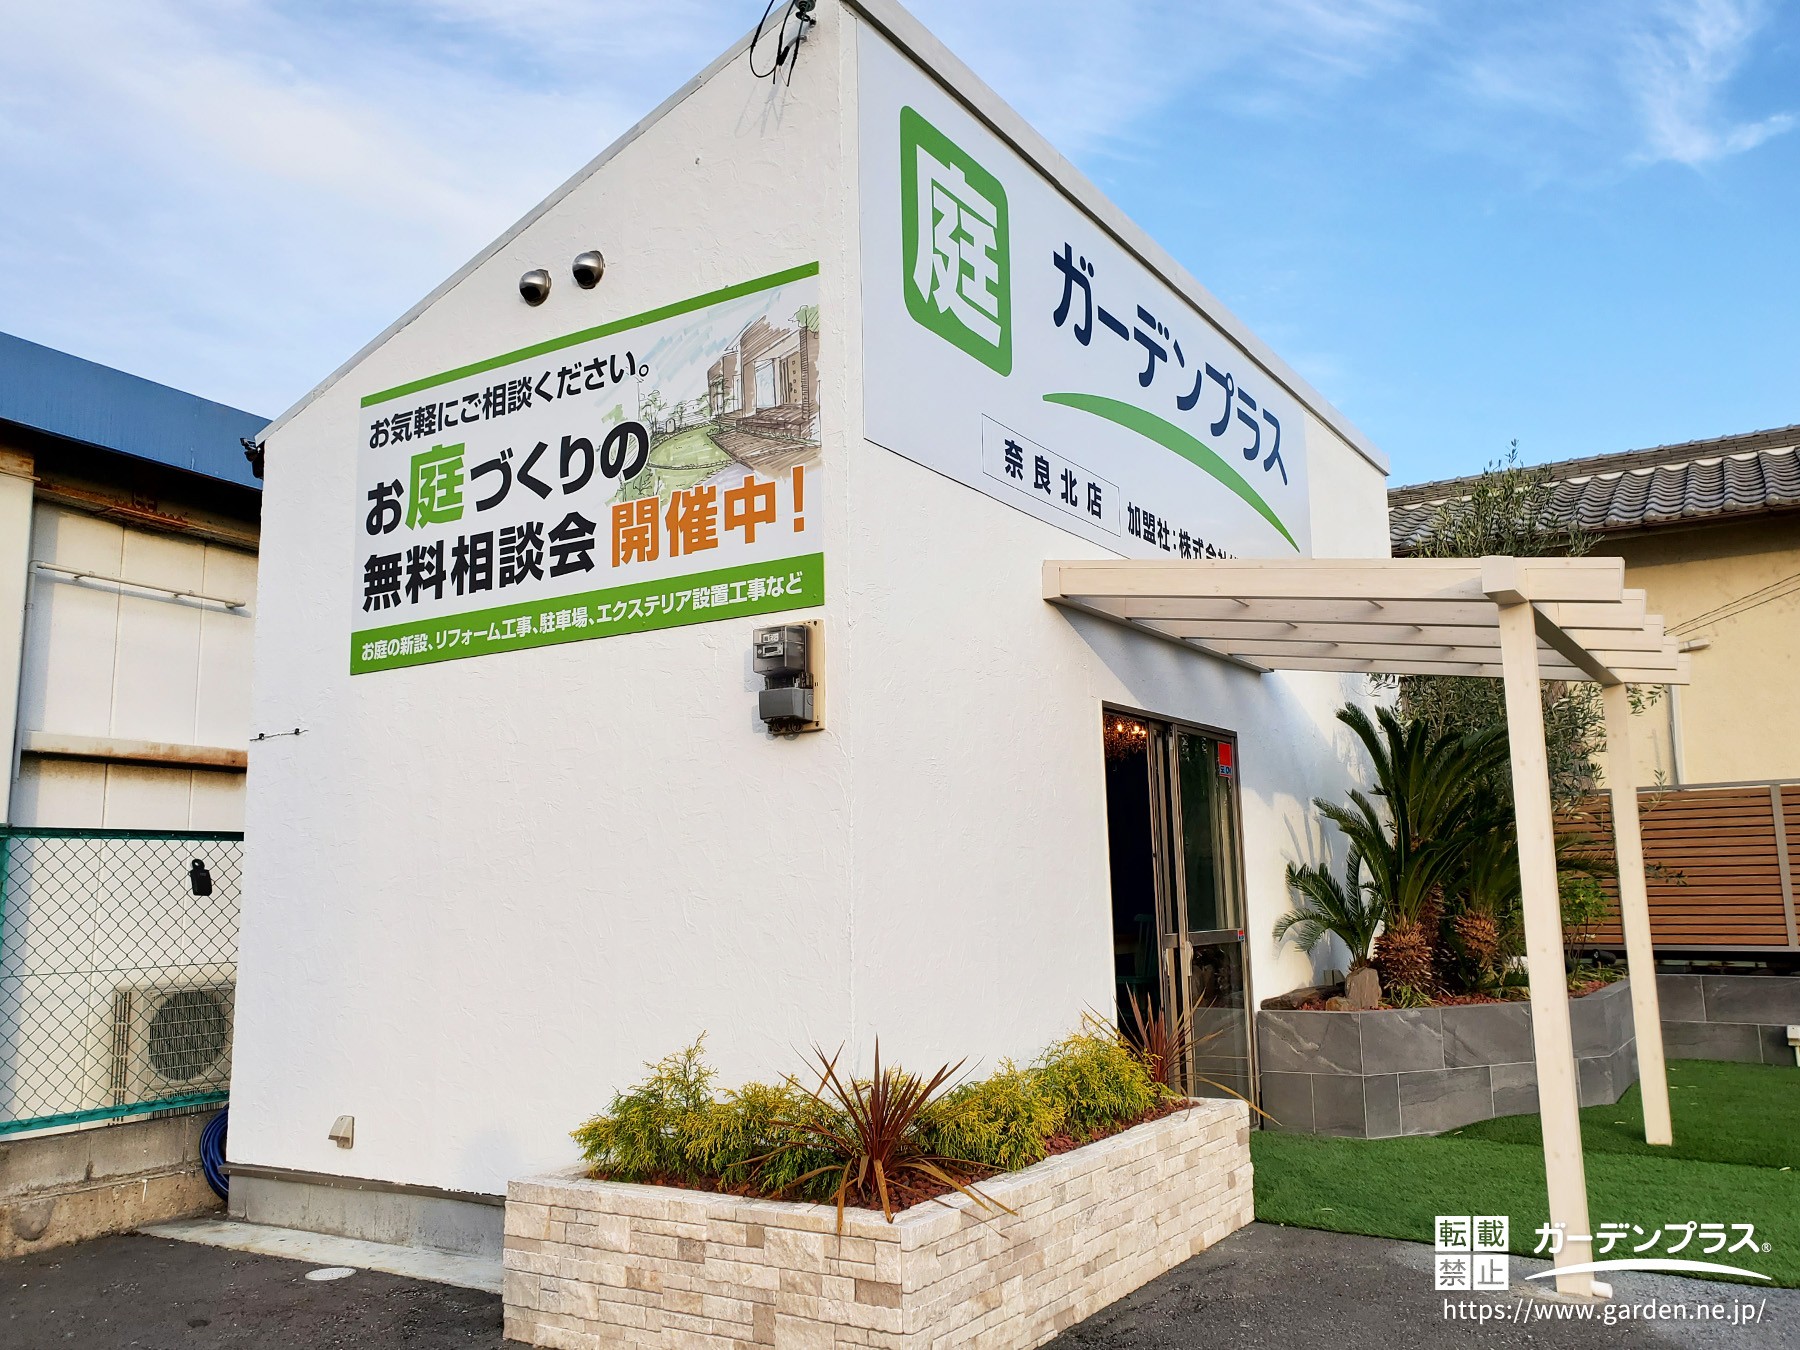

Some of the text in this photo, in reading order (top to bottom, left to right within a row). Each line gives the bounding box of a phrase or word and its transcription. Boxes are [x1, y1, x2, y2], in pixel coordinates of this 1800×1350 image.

[912, 143, 1002, 349] 庭
[369, 350, 650, 449] お気軽にご相談ください。
[1052, 241, 1288, 486] ガーデンプラス
[366, 421, 650, 536] お庭づくりの
[1004, 439, 1102, 520] 奈良北店
